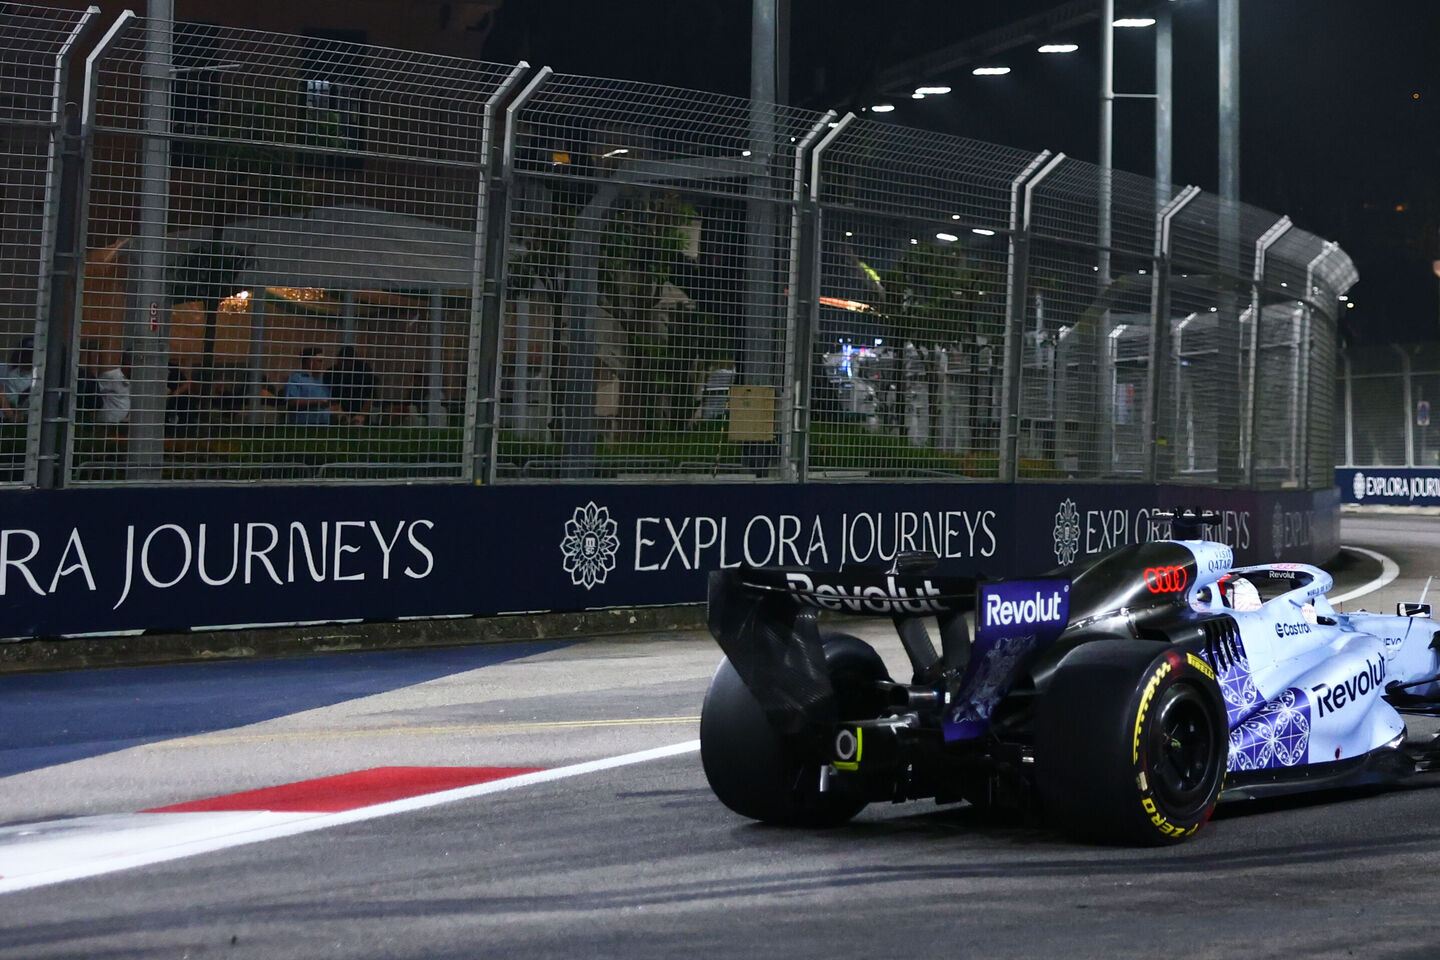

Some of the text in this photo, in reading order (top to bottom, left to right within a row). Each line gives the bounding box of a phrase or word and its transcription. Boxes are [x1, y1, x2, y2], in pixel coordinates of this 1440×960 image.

[1366, 476, 1410, 497] EXPLORA
[634, 510, 996, 573] EXPLORA JOURNEYS
[0, 518, 435, 610] RA JOURNEYS
[1208, 558, 1232, 574] QATAR
[1268, 570, 1295, 579] Revolut
[785, 572, 950, 614] Revolut
[985, 591, 1062, 627] Revolut
[1283, 622, 1312, 636] Castrol
[1186, 652, 1215, 681] PIRELLI
[1312, 651, 1386, 718] Revolut
[1142, 797, 1186, 838] ZERO
